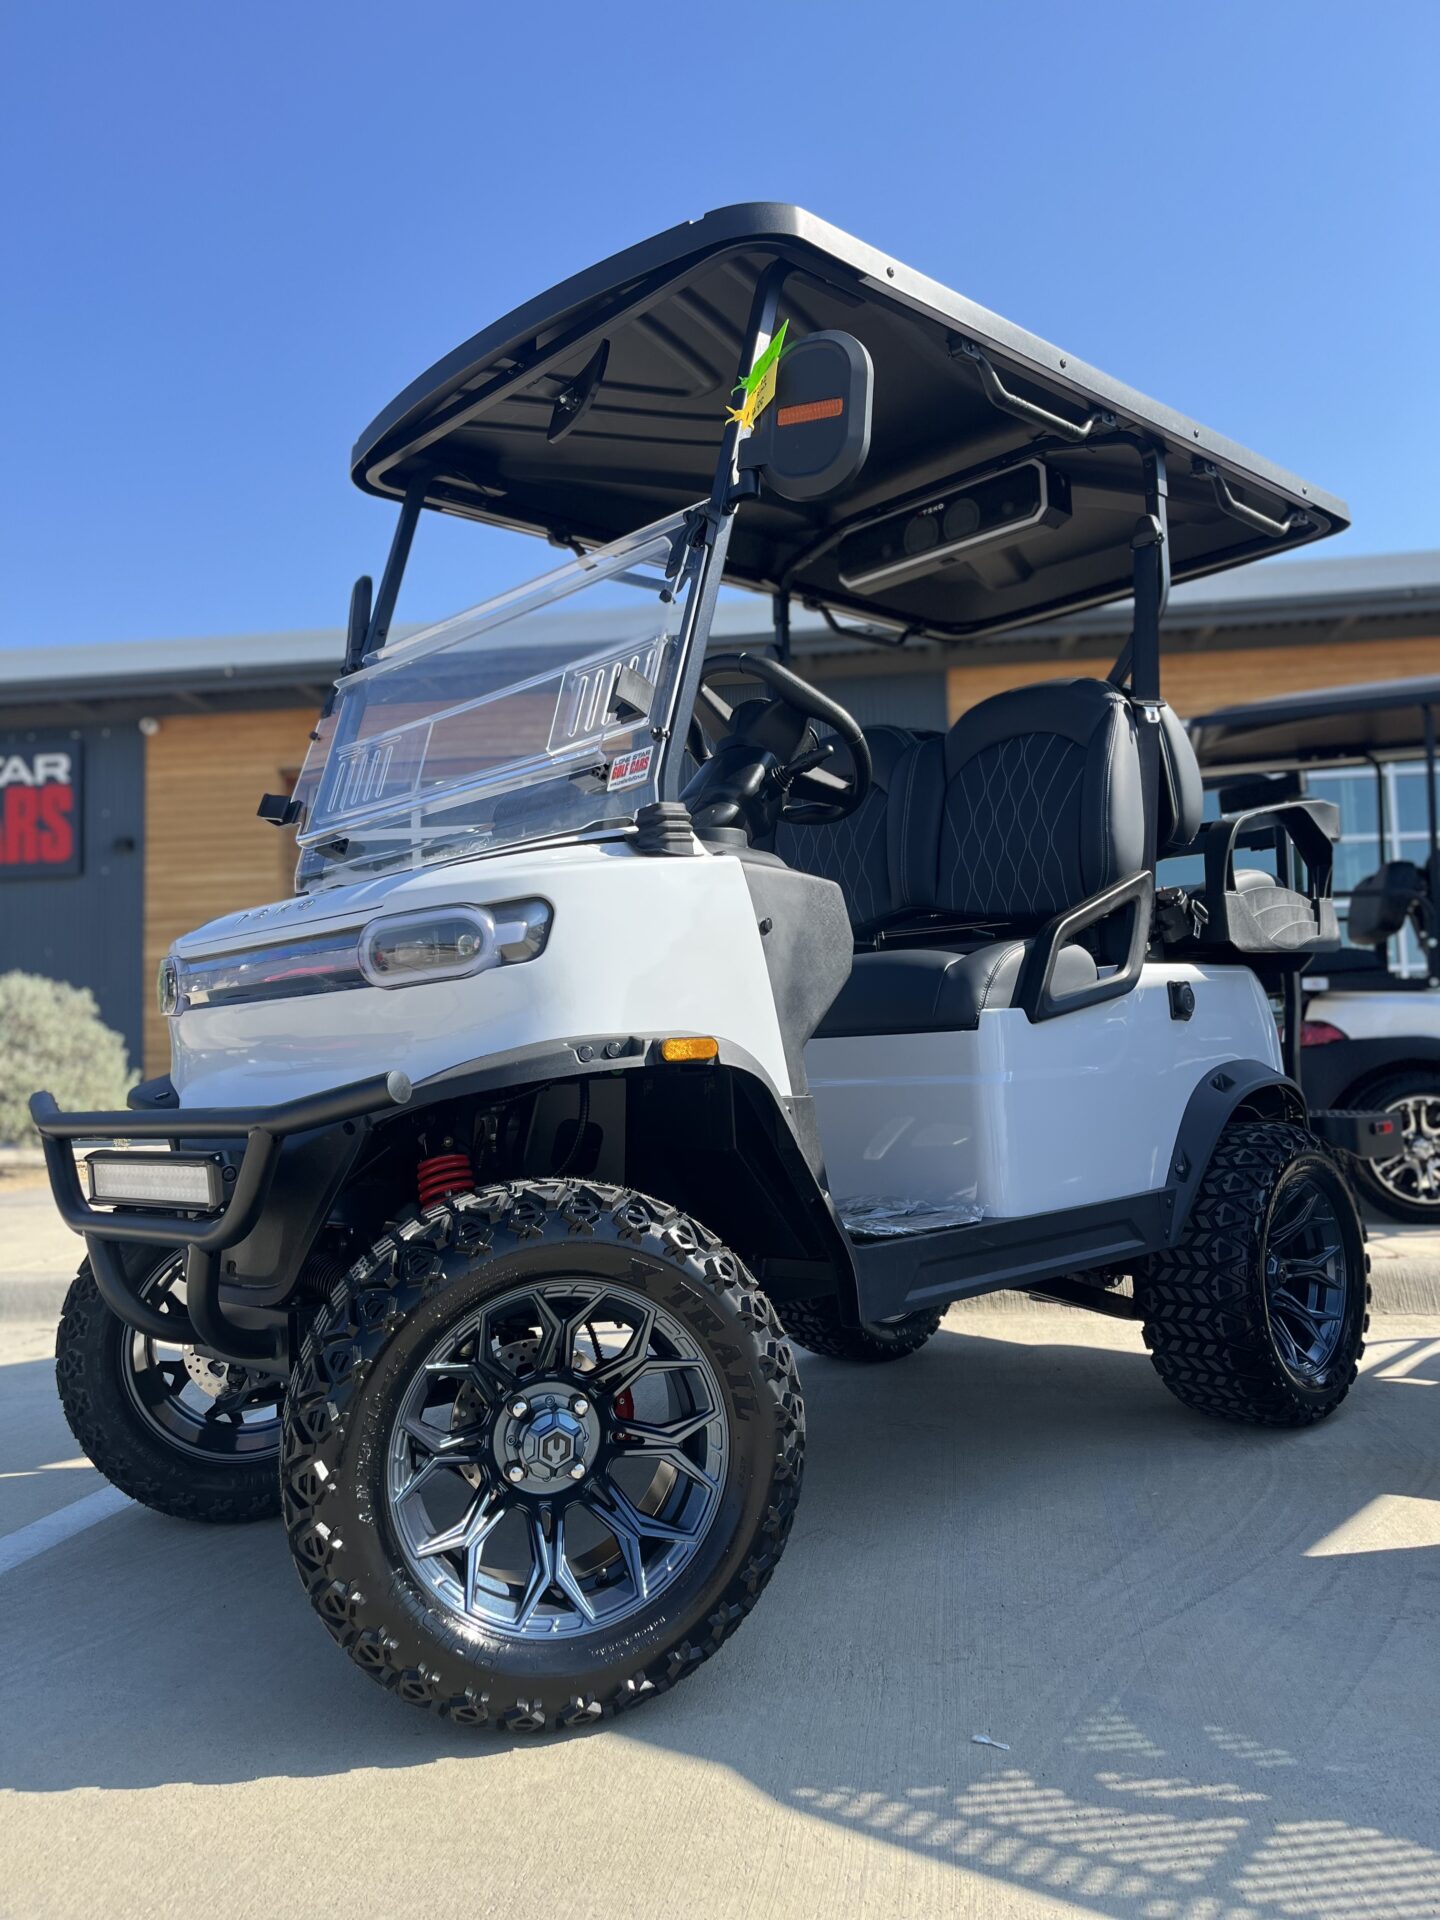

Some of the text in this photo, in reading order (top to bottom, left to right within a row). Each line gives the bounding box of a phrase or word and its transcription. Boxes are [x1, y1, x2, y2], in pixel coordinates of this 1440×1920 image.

[0, 752, 72, 787] AR
[611, 762, 630, 780] GOLF
[629, 756, 650, 775] CARS
[614, 749, 651, 765] LONE STAR
[0, 784, 74, 865] RS
[662, 1281, 760, 1422] TRAIL
